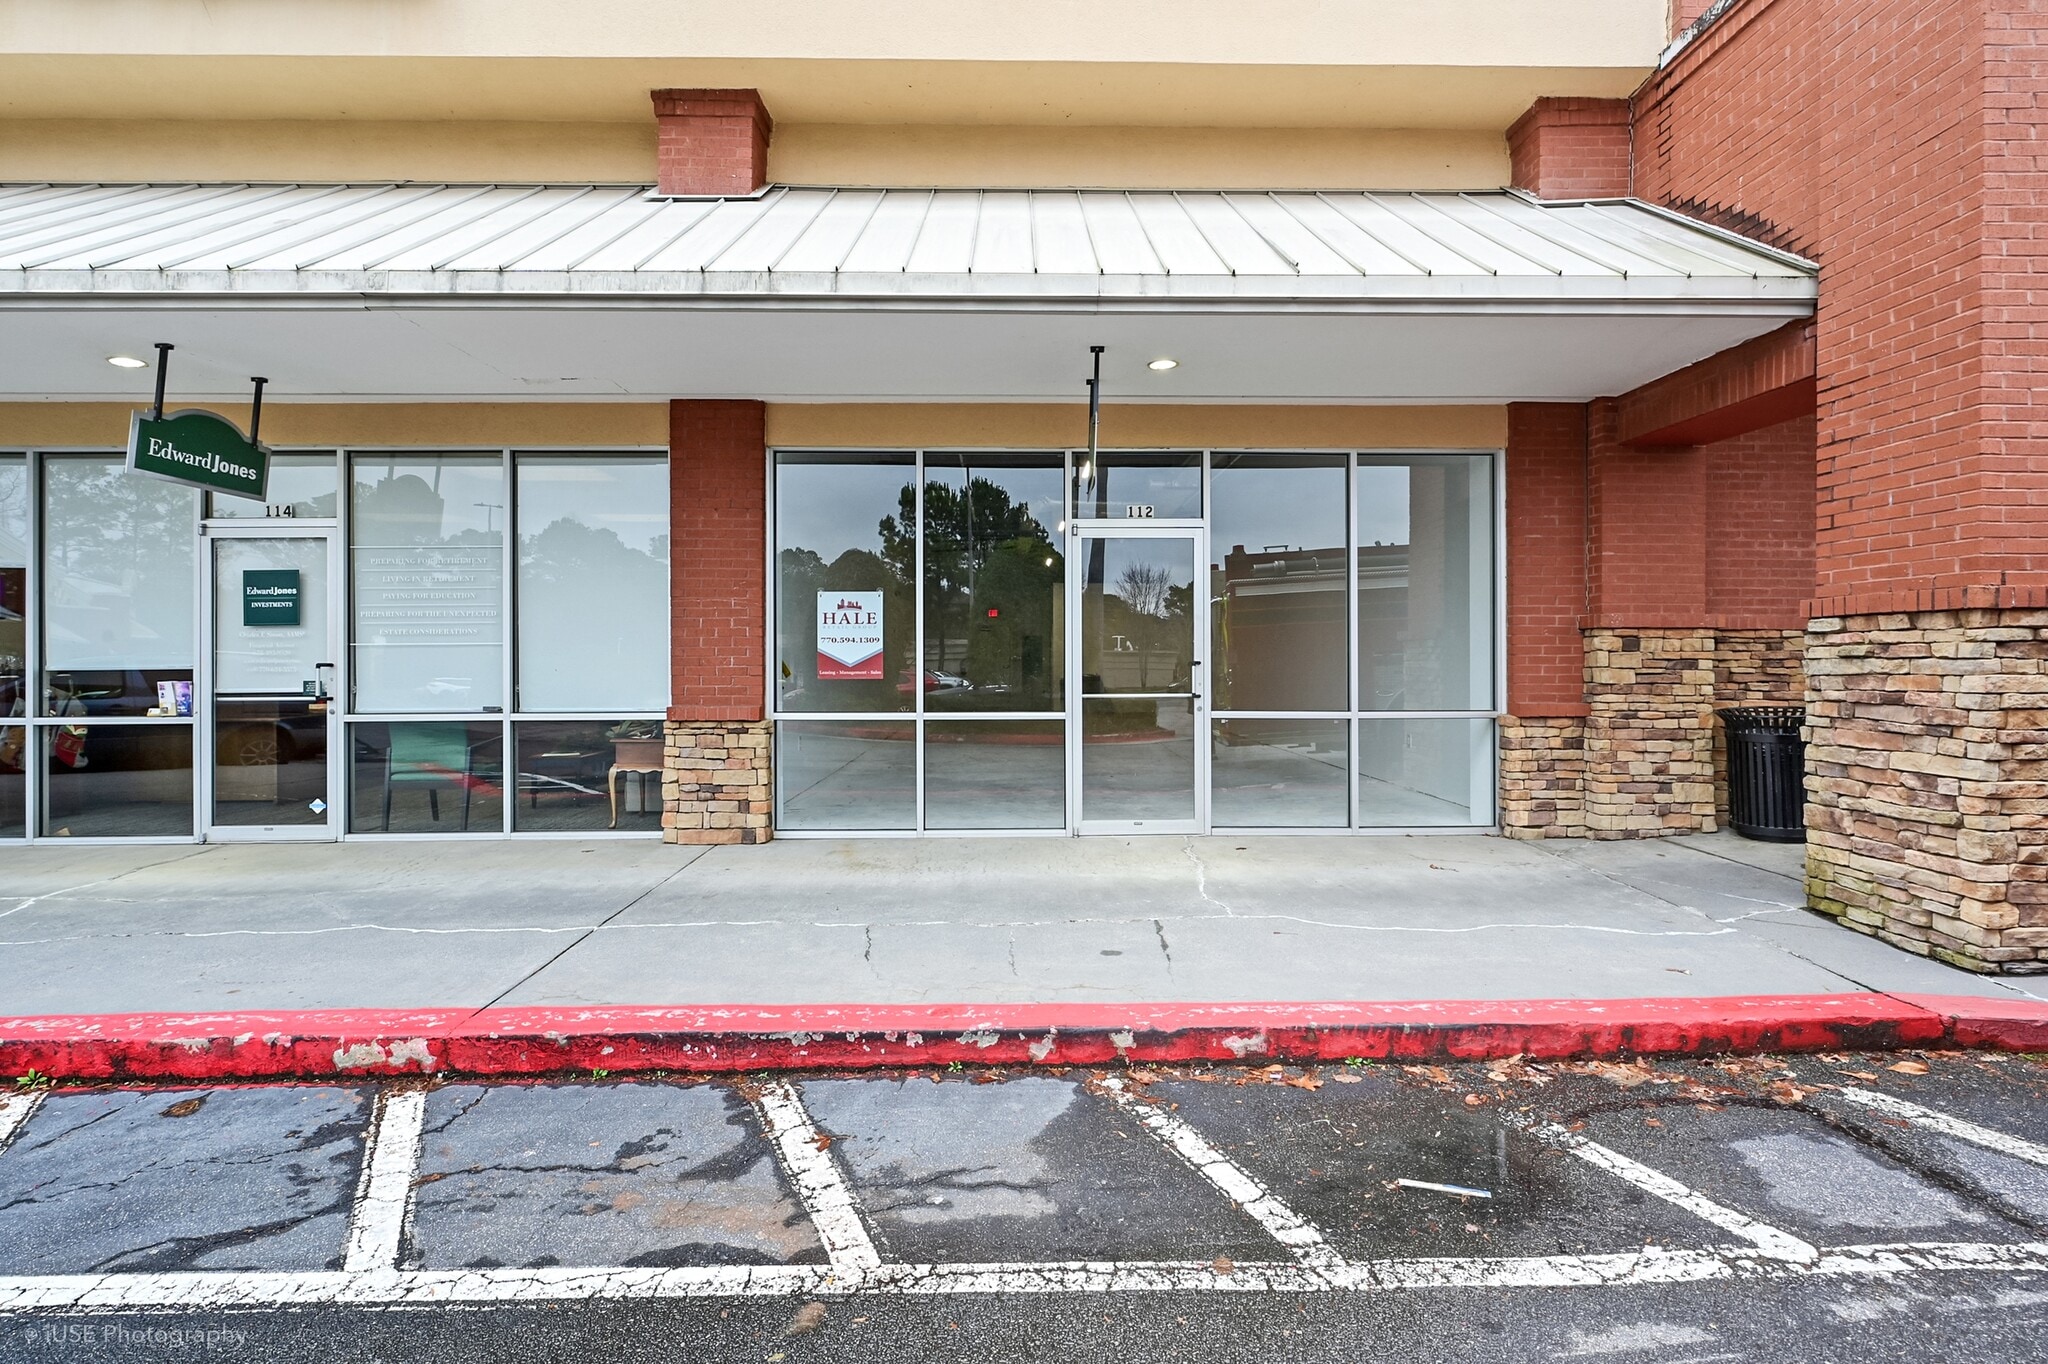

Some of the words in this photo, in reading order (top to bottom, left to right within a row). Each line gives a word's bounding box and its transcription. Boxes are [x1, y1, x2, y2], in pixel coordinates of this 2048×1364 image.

[265, 505, 292, 517] 114
[1128, 506, 1153, 518] 112
[370, 557, 415, 565] PREPARING
[417, 557, 434, 565] FOR
[435, 557, 488, 565] RETIREMENT
[382, 575, 410, 583] LIVING
[412, 575, 421, 583] IN
[422, 575, 475, 583] RETIREMENT
[360, 610, 405, 618] PREPARING
[822, 612, 878, 625] HALE
[820, 636, 880, 644] 770.594.1309
